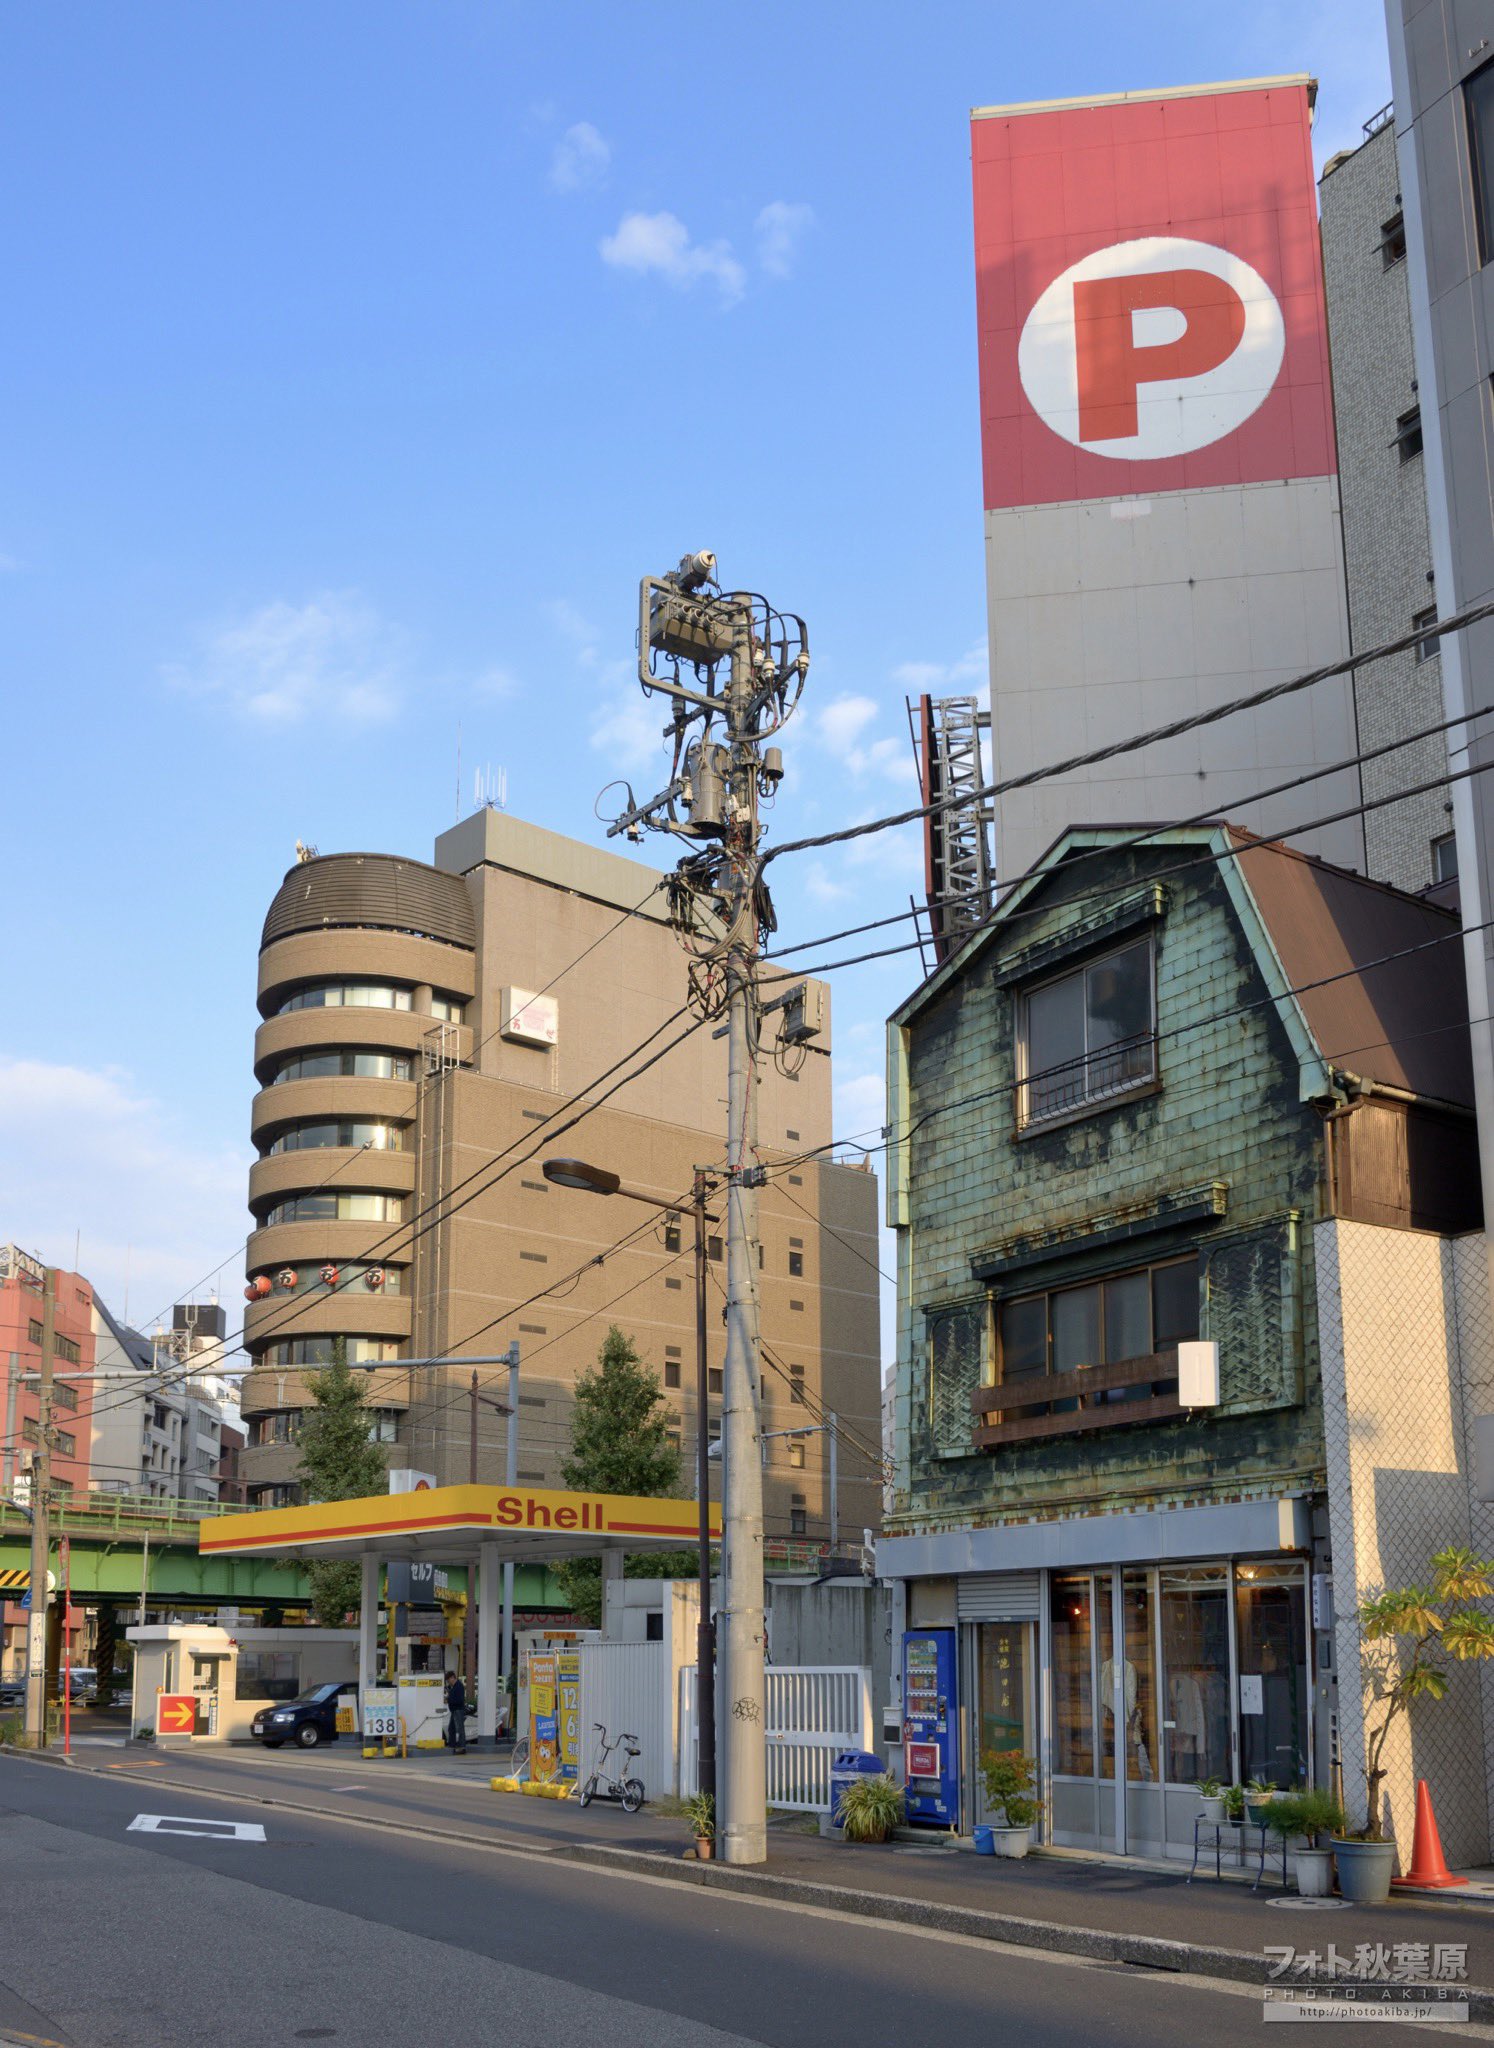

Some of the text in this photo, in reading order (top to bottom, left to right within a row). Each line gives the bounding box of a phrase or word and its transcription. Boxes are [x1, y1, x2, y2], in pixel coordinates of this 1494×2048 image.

[1073, 268, 1246, 443] P
[368, 1269, 381, 1283] 万
[497, 1497, 603, 1530] Shell
[411, 1563, 433, 1581] セルフ
[563, 1687, 578, 1709] 12
[366, 1719, 395, 1733] 138
